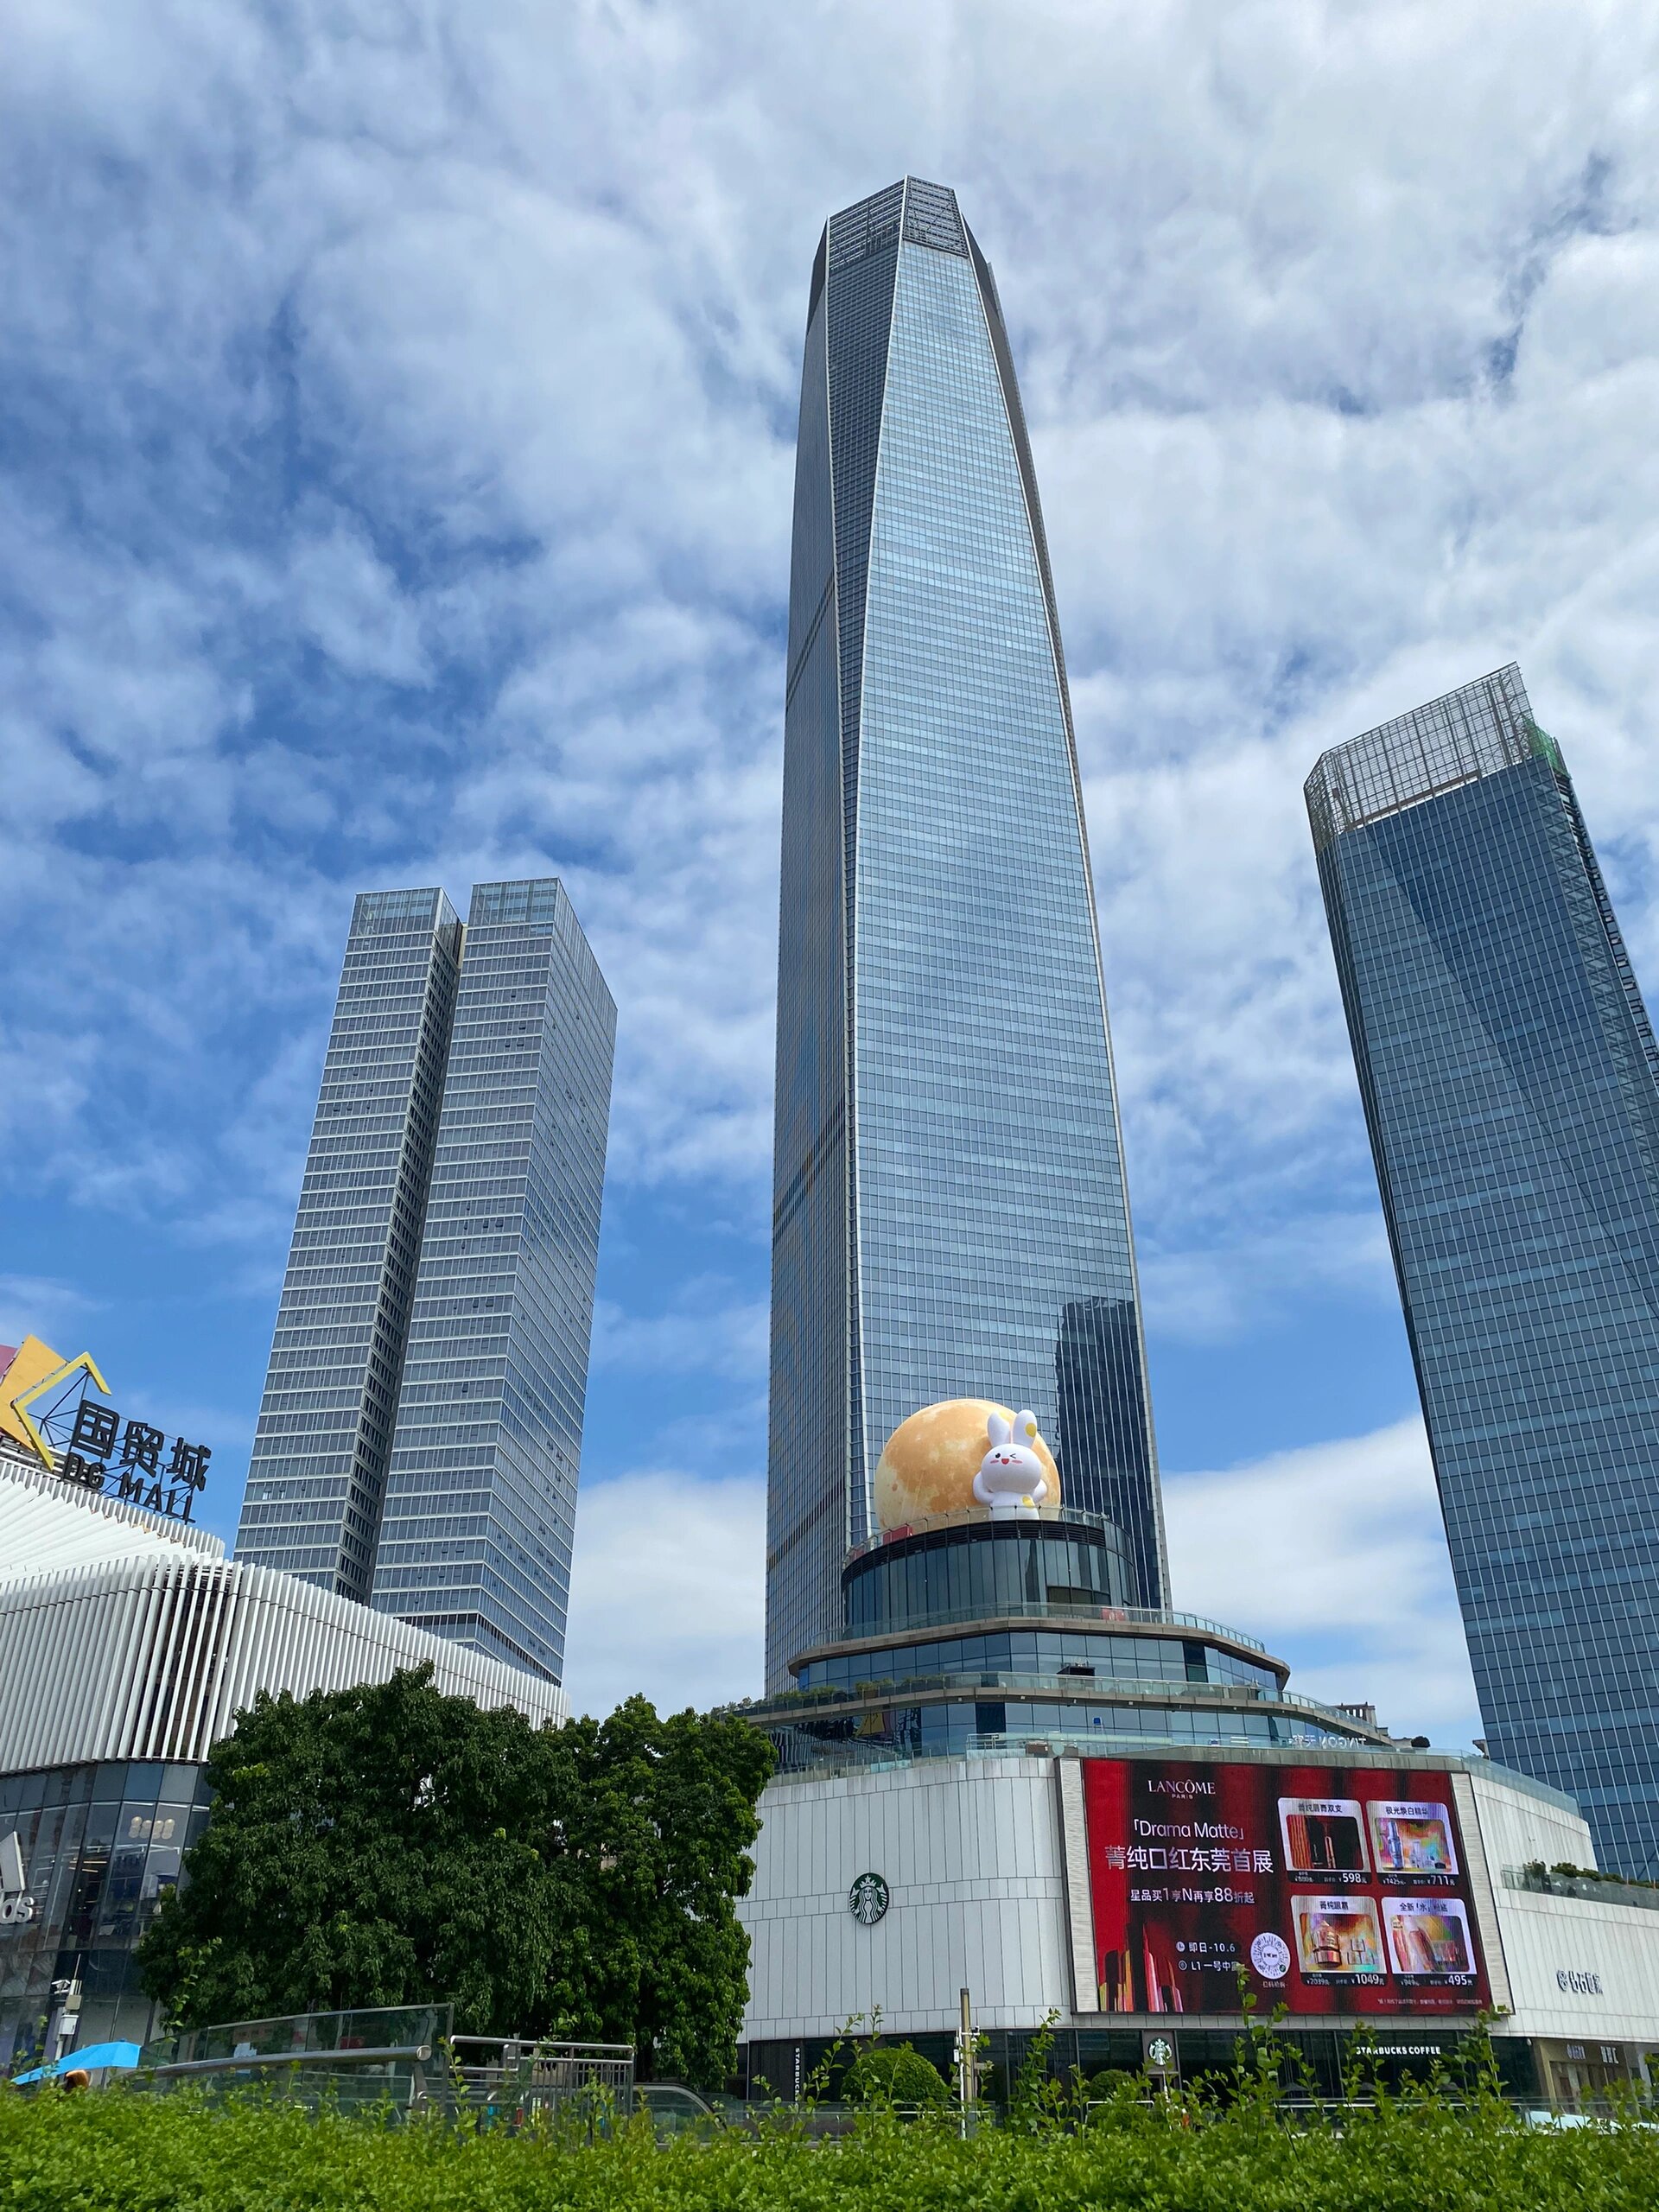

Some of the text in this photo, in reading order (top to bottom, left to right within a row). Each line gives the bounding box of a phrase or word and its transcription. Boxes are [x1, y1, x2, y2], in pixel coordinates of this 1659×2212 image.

[70, 1399, 212, 1491] 国贸城
[1147, 1778, 1216, 1795] LANCÔME
[1104, 1845, 1274, 1873] 菁纯口红东莞首展
[1408, 2046, 1441, 2055] COFFEE
